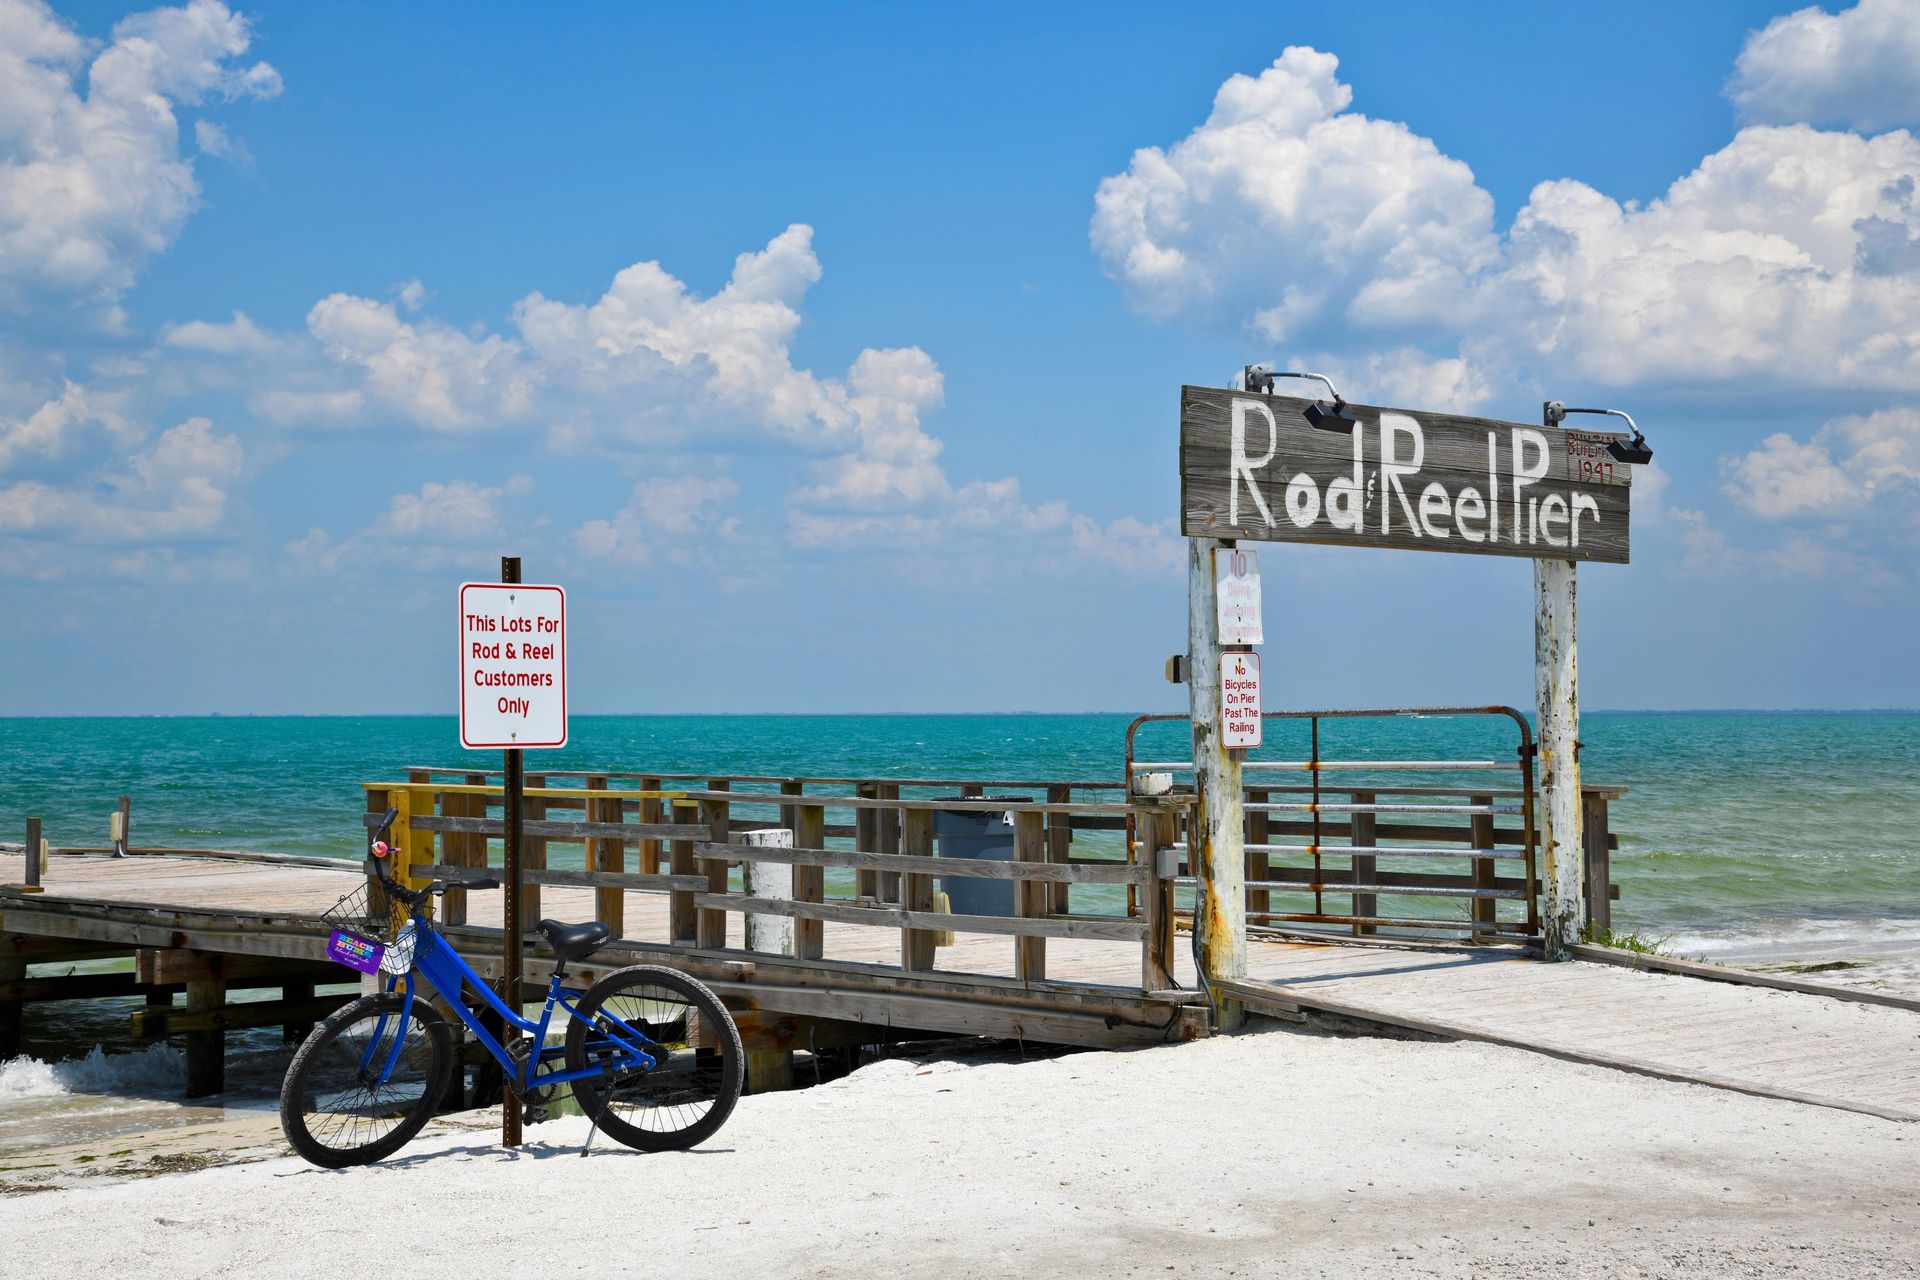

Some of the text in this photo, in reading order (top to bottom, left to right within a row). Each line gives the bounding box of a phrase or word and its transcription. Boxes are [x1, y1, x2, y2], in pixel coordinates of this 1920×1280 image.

[1230, 397, 1364, 535] Rod
[1379, 411, 1498, 544] Reel
[1511, 427, 1601, 548] Pier
[1575, 459, 1613, 486] 1947
[1230, 552, 1247, 577] NO
[466, 614, 560, 633] This Lots For
[472, 642, 554, 660] Rod & Reel
[474, 669, 553, 687] Customers
[1235, 665, 1246, 675] No
[1225, 679, 1257, 692] Bicycles
[497, 696, 530, 718] Only
[1227, 693, 1256, 704] On Pier
[1224, 707, 1258, 719] Past The
[1229, 722, 1255, 735] Railing
